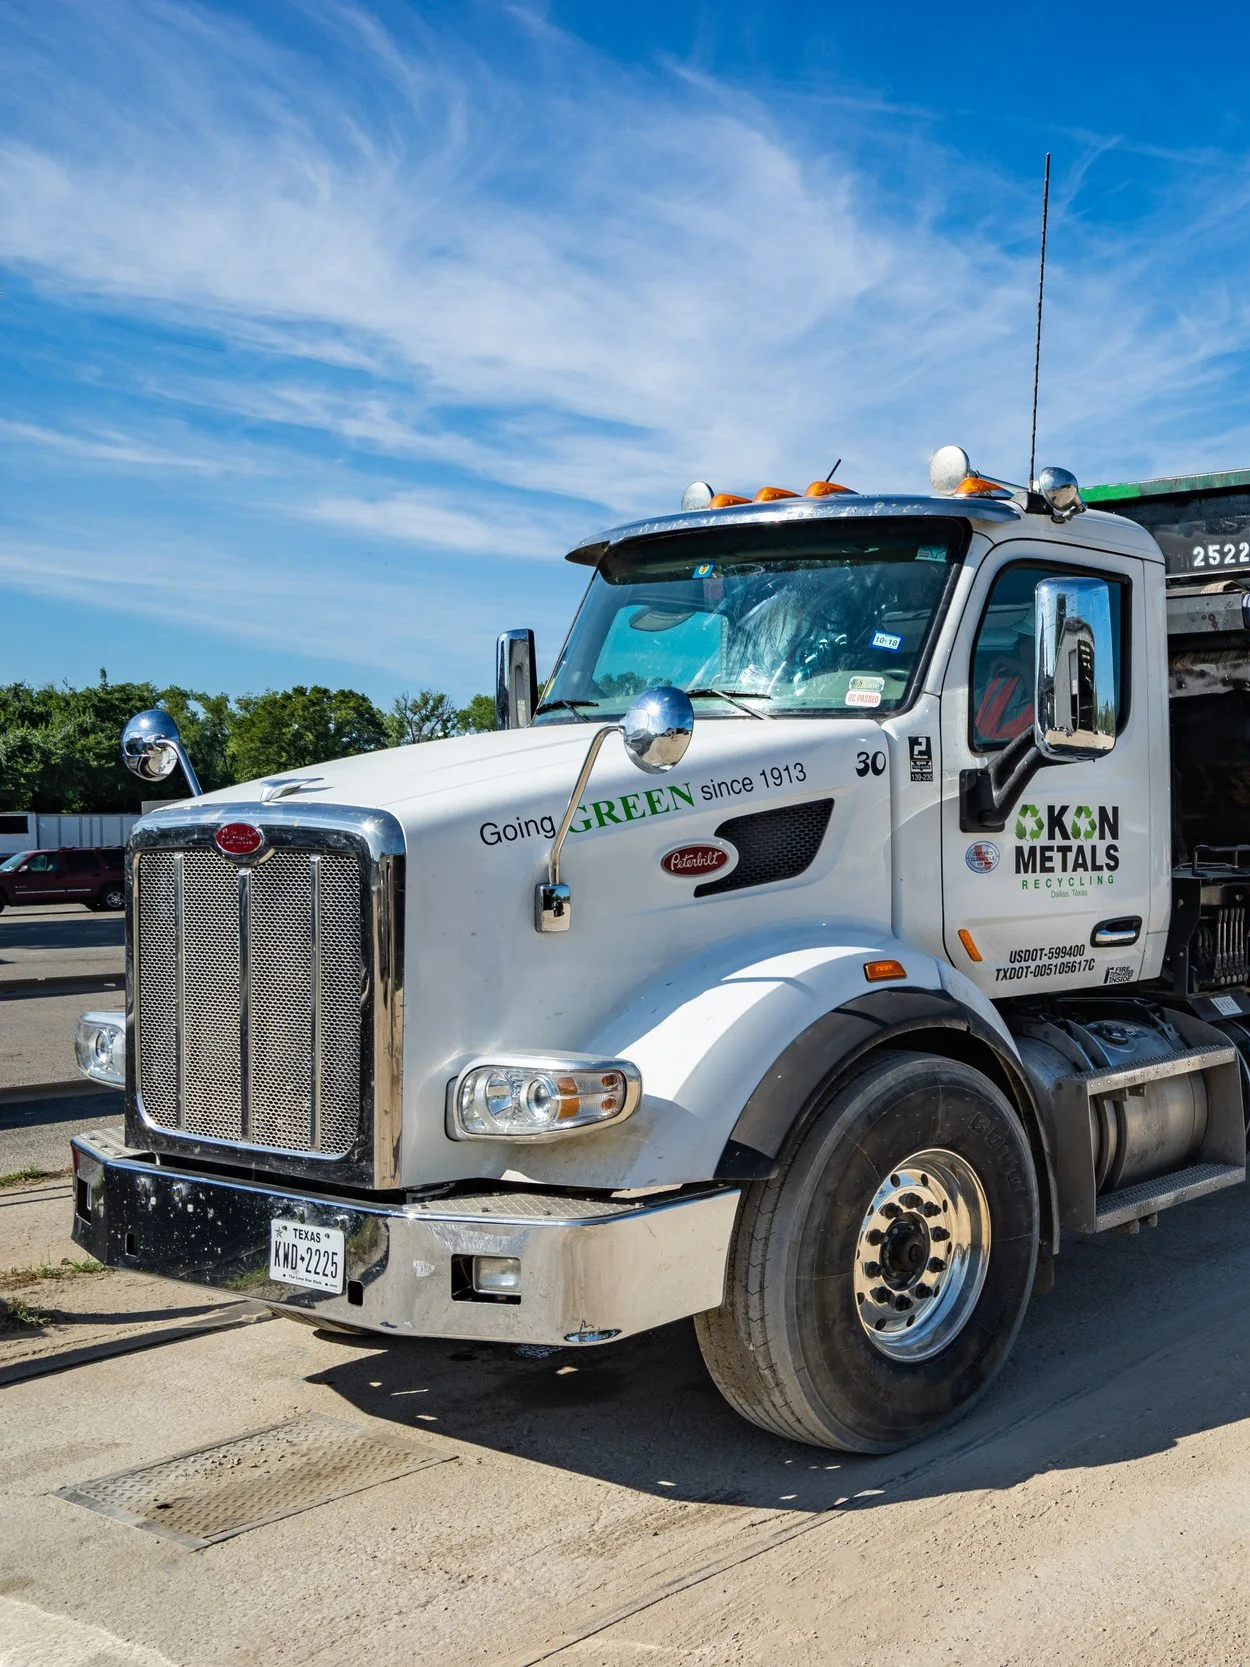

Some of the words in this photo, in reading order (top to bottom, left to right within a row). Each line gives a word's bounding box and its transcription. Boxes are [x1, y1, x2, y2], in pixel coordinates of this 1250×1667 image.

[876, 636, 898, 647] 10-18
[856, 751, 886, 777] 30
[479, 815, 556, 847] Going
[701, 774, 754, 801] since
[760, 762, 808, 788] 1913
[670, 850, 723, 870] Peterbilt
[1015, 844, 1120, 874] METALS
[1021, 875, 1114, 890] RECYCLING
[1072, 889, 1088, 897] Texas
[1009, 944, 1086, 964] USDOT-599400
[995, 958, 1096, 981] TXDOT-005105617C
[293, 1228, 321, 1243] TEXAS
